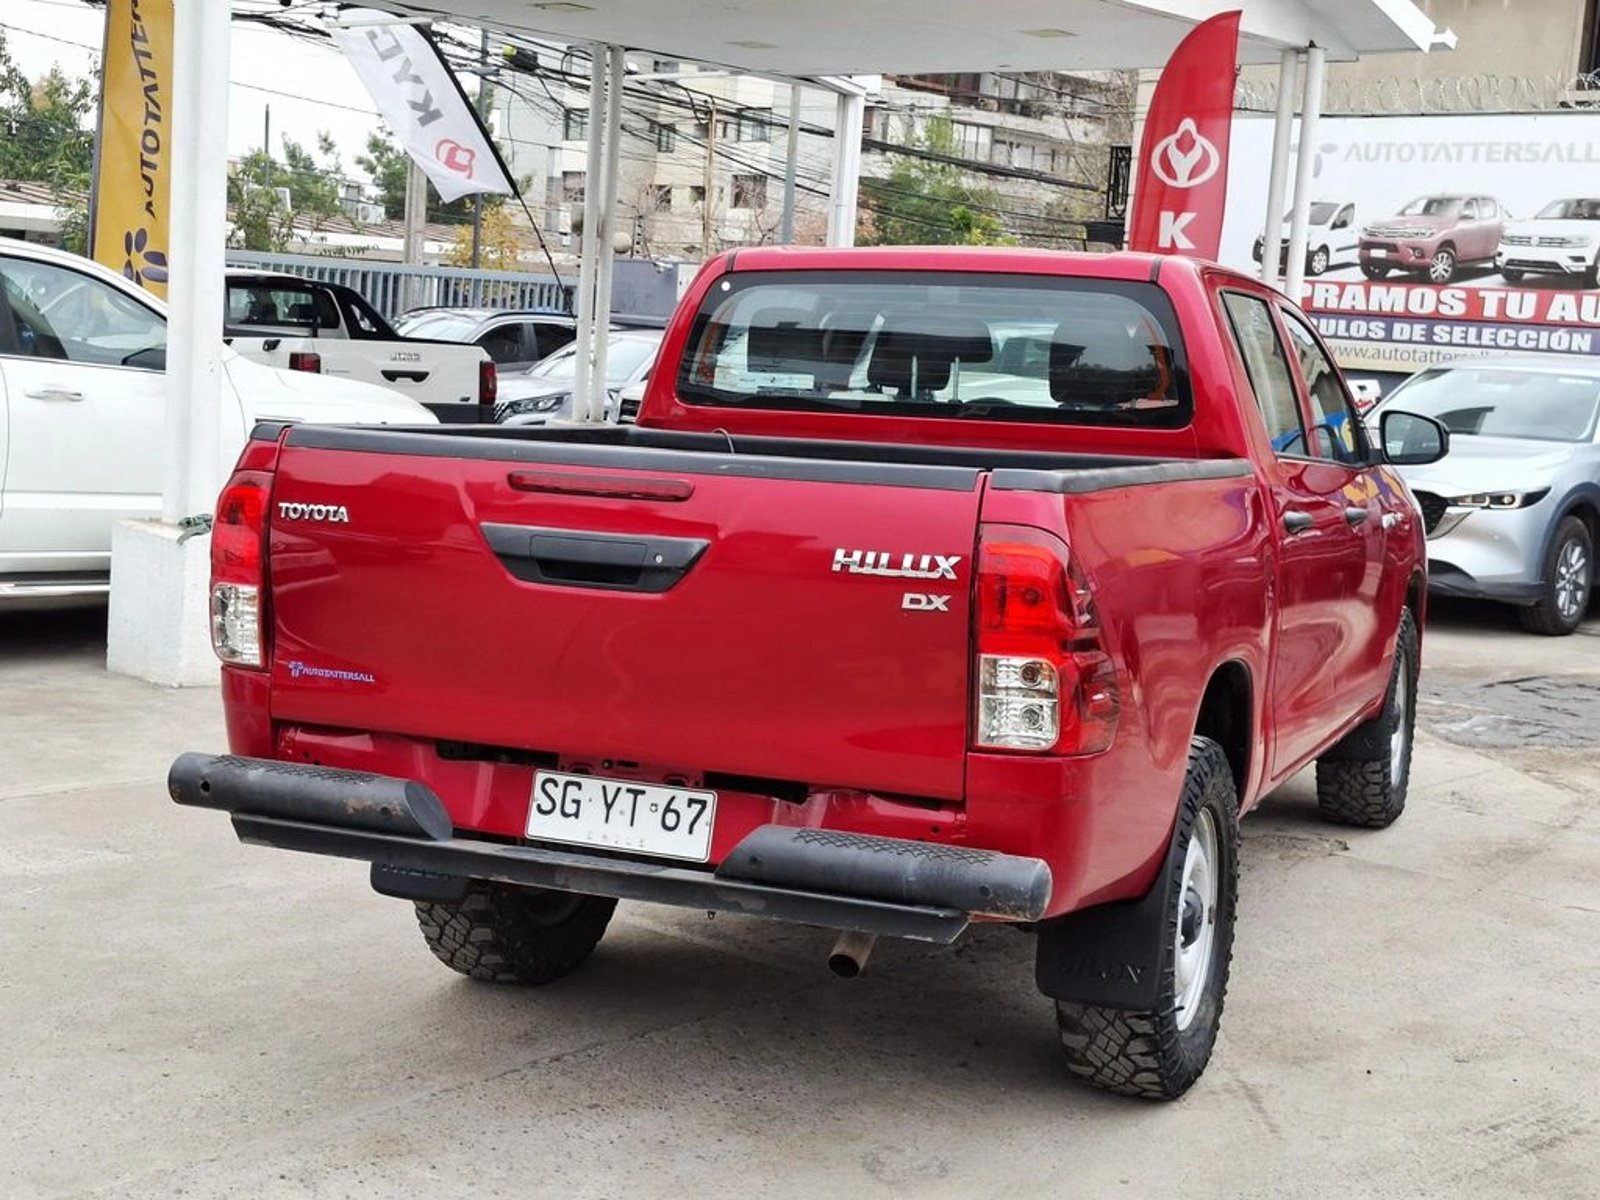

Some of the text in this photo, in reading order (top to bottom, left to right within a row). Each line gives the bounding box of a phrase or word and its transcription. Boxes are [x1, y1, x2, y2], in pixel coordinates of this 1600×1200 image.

[1344, 141, 1600, 164] AUTOTATTERSALL
[1158, 211, 1198, 249] K
[1478, 291, 1538, 320] TU
[1546, 293, 1600, 324] AU
[1310, 317, 1593, 352] ULOS DE SELECCIÓN
[278, 502, 350, 523] TOYOTA
[831, 548, 962, 580] HILUX
[901, 592, 952, 612] DX
[302, 667, 376, 683] AUTOTATTERSALL
[535, 777, 708, 836] SG YT 67
